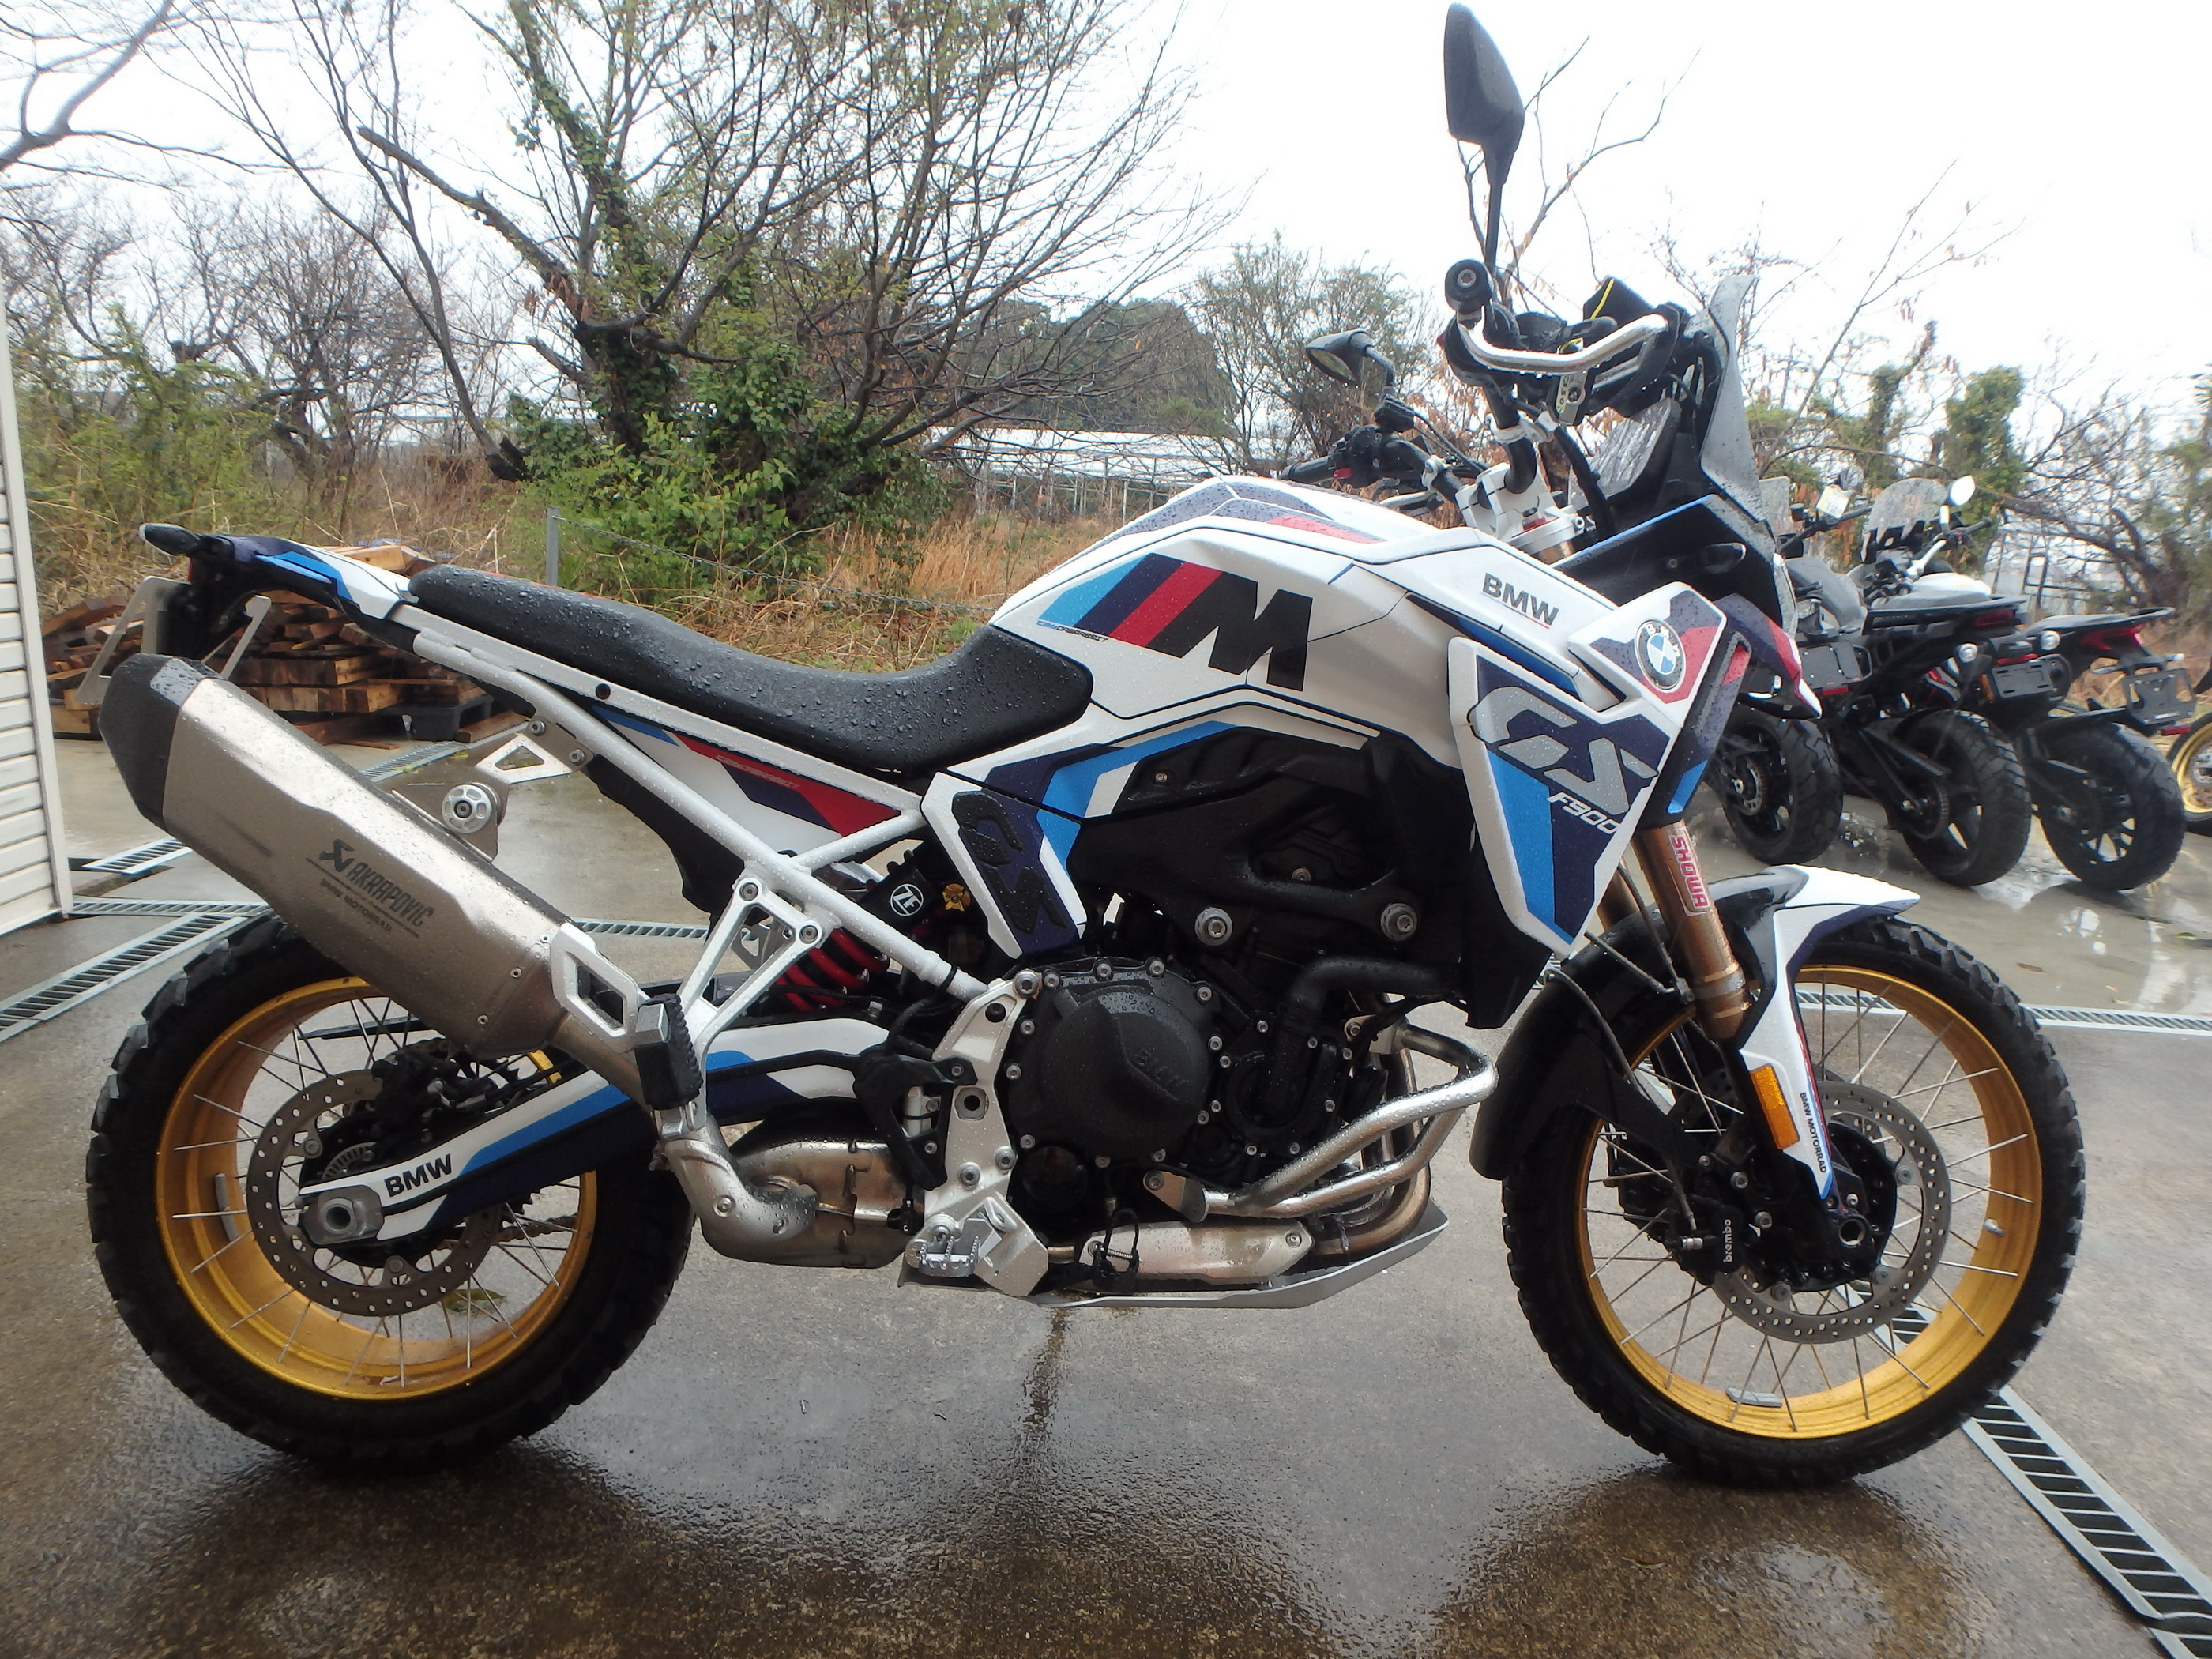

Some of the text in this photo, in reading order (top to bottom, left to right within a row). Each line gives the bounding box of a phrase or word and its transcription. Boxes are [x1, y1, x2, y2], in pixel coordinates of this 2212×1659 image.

[1482, 572, 1559, 626] BMW
[1546, 792, 1622, 834] F900
[1670, 836, 1710, 907] SHOWA
[320, 878, 393, 931] BMW MOTORRAD
[891, 884, 923, 916] ZF
[1800, 1092, 1827, 1173] BMW MOTORRAD
[384, 1153, 452, 1198] BMW
[1722, 1219, 1732, 1262] brembo
